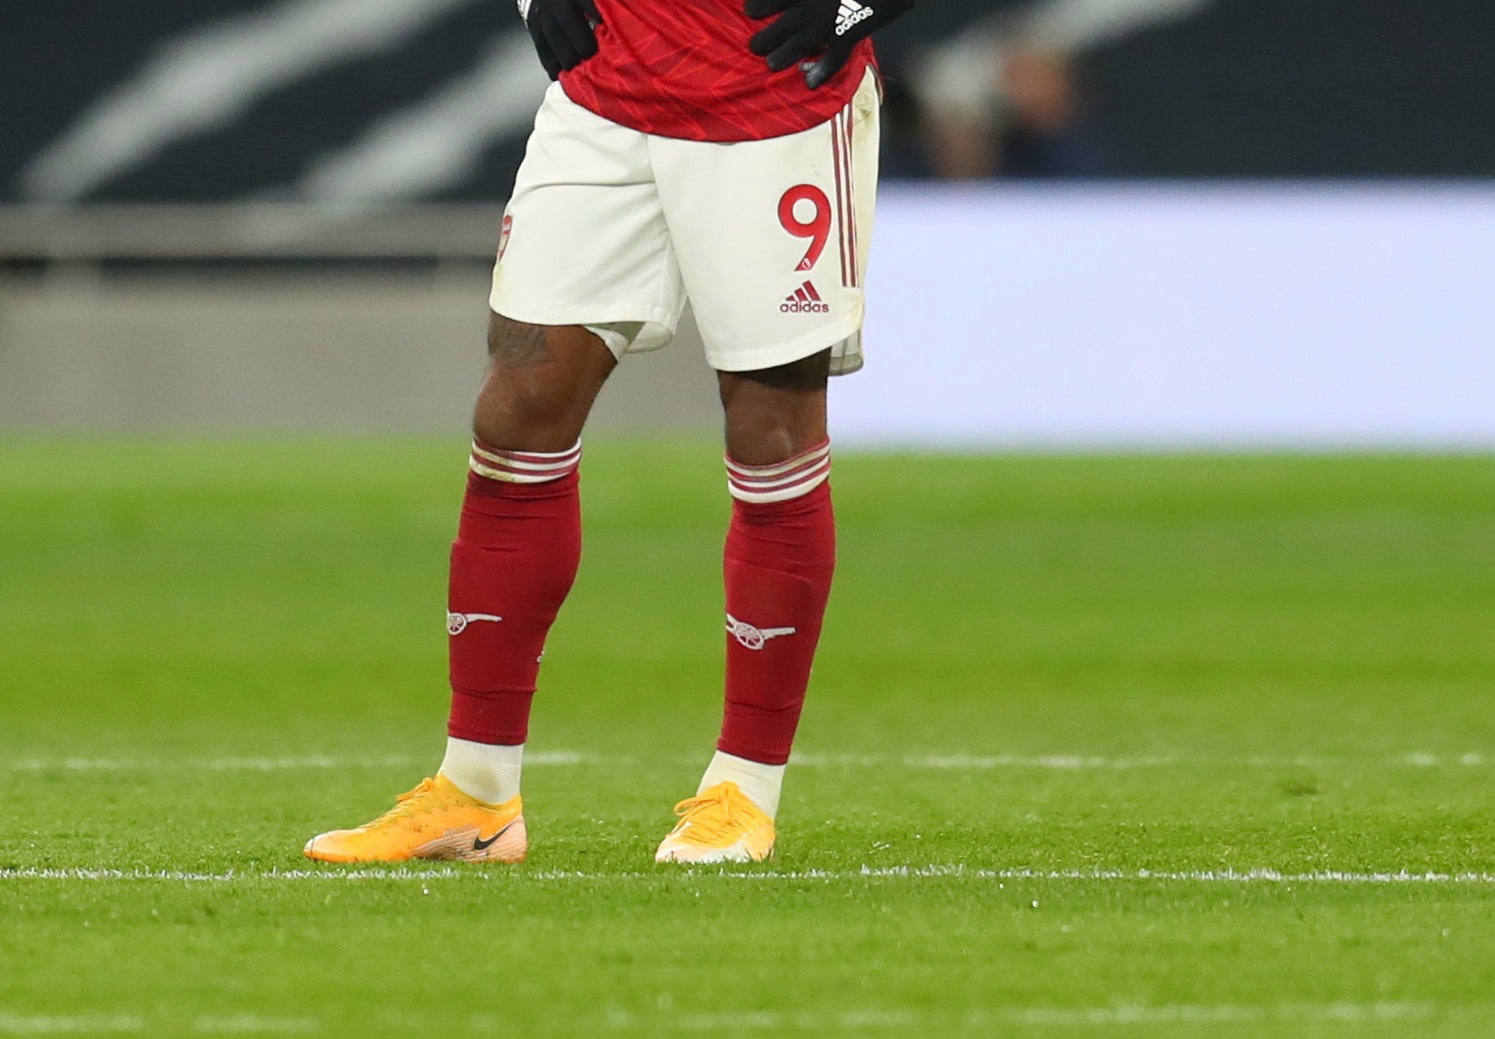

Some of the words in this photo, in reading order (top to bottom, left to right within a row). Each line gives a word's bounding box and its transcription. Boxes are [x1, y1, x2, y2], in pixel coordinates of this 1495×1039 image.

[835, 6, 874, 36] adidas
[778, 184, 831, 271] 9
[779, 301, 830, 313] adidas
